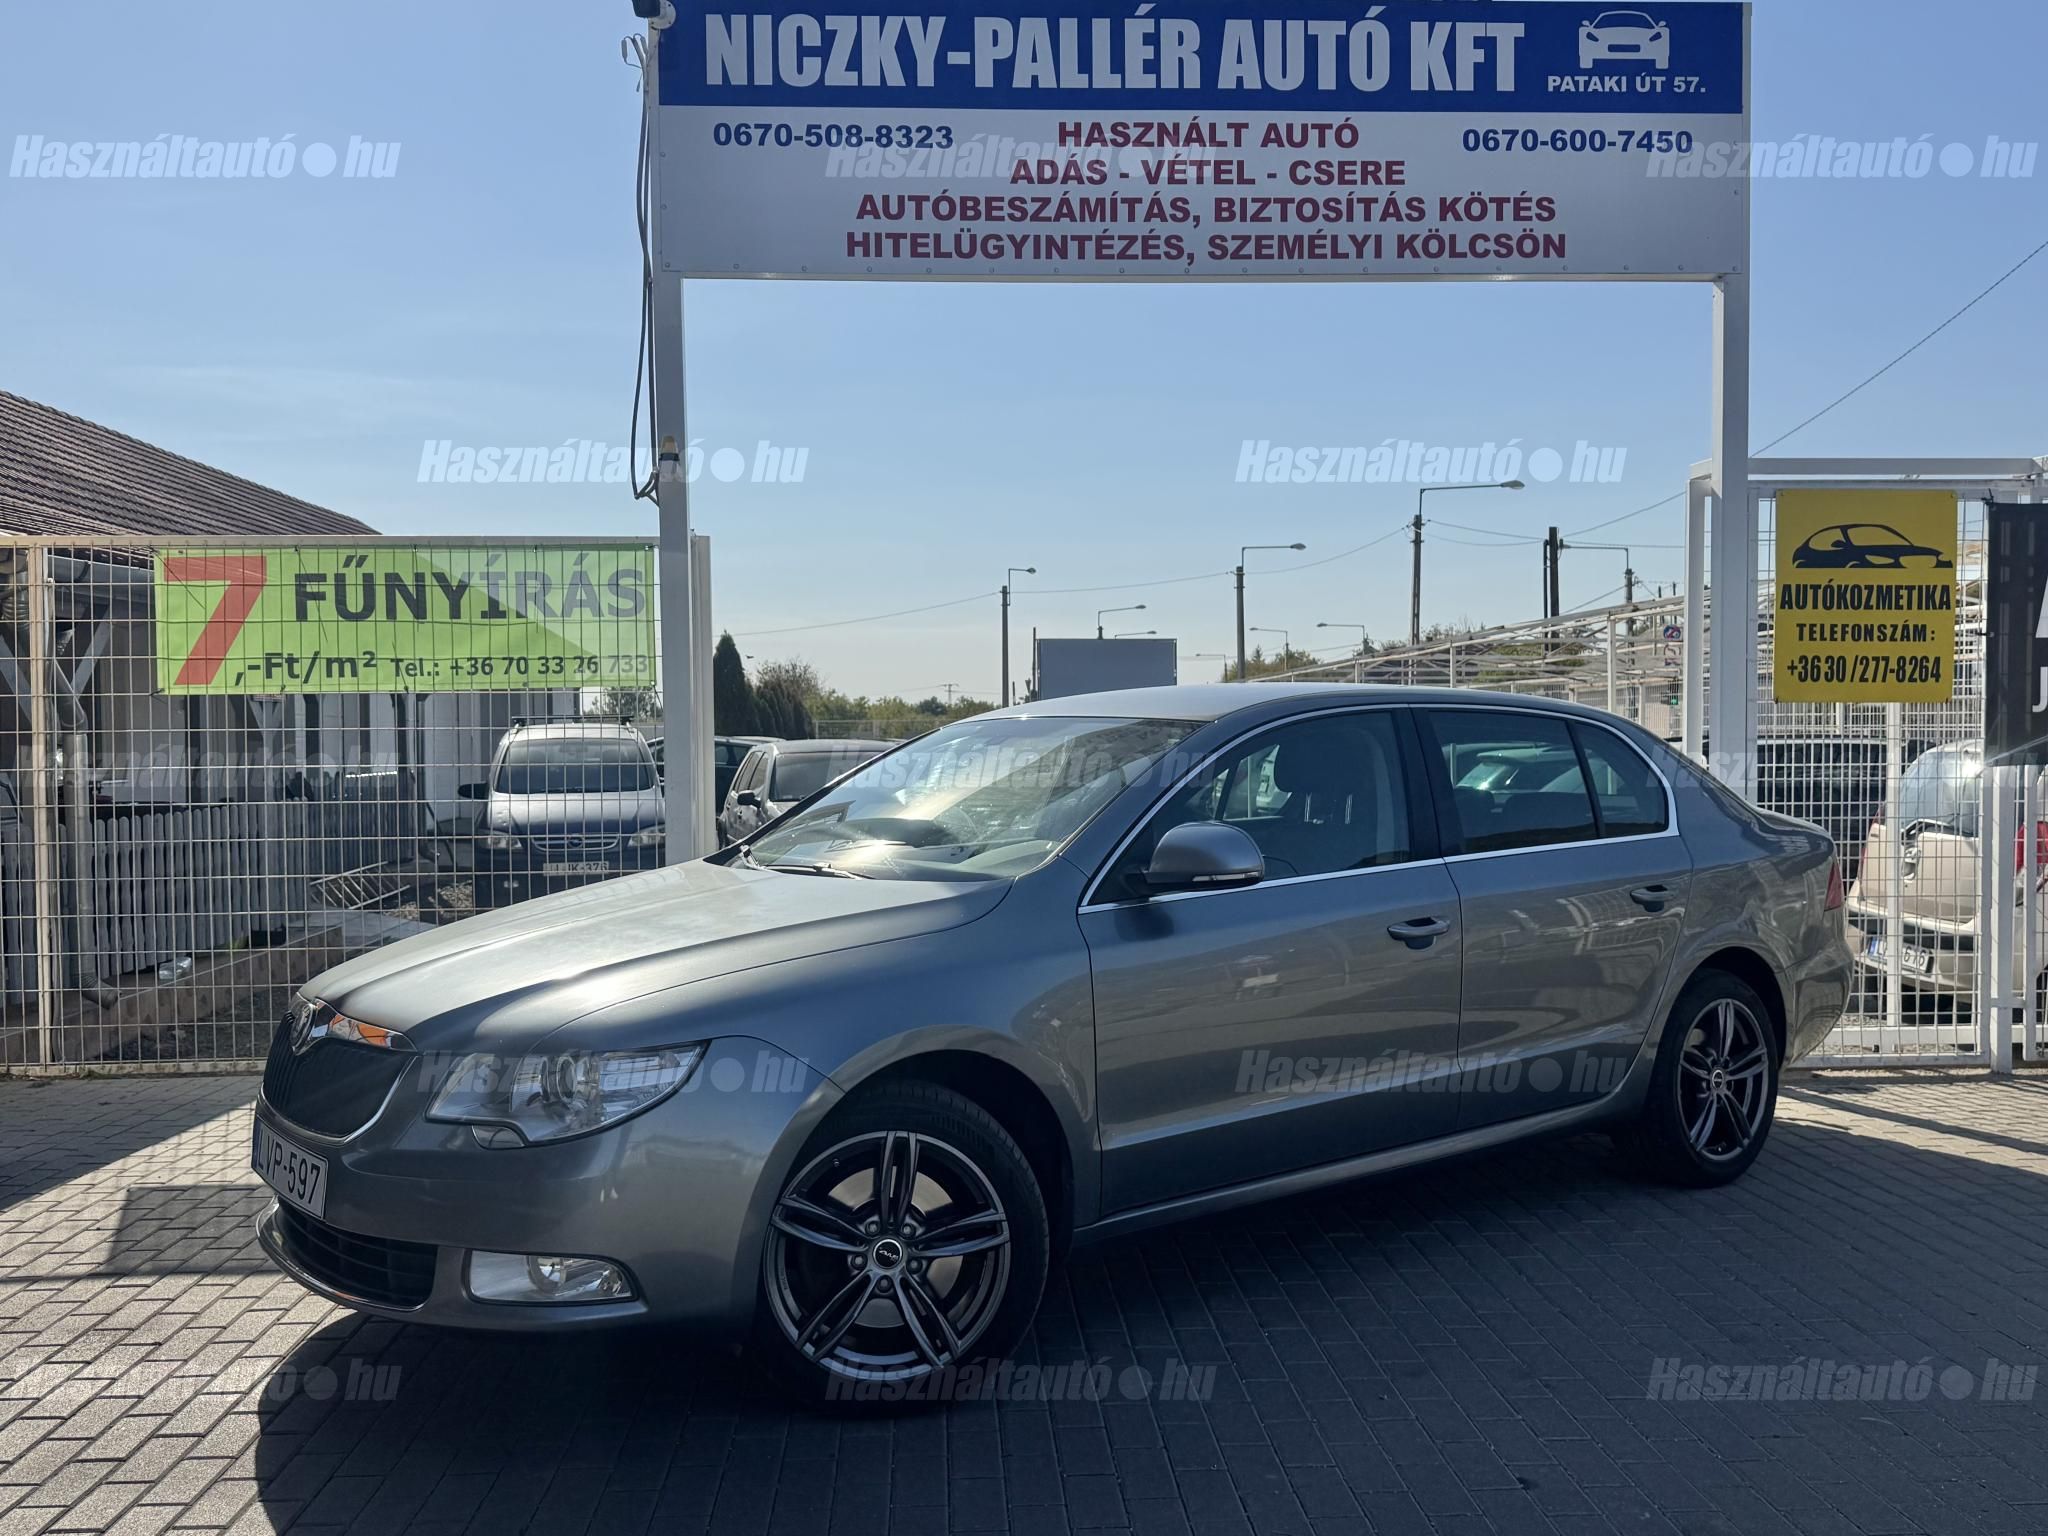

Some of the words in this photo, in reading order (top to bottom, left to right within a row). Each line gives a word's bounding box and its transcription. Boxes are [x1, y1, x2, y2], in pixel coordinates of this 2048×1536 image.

[706, 4, 1200, 88] NICZKY-PALLÉR
[1218, 6, 1390, 91] AUTÓ
[1411, 21, 1525, 91] KFT
[1547, 76, 1627, 92] PATAKI
[1636, 72, 1666, 92] ÚT
[1673, 76, 1706, 93] 57.
[714, 122, 953, 149] 0670-508-8323
[1058, 116, 1249, 148] HASZNÁLT
[1261, 117, 1359, 149] AUTÓ
[1462, 129, 1693, 154] 0670-600-7450
[1010, 155, 1107, 185] ADÁS
[1143, 155, 1256, 186] VÉTEL
[1289, 159, 1406, 186] CSERE
[856, 190, 1200, 228] AUTÓBESZÁMÍTÁS,
[1214, 192, 1426, 224] BIZTOSÍTÁS
[1439, 192, 1556, 223] KÖTÉS
[847, 228, 1195, 265] HITELÜGYINTÉZÉS,
[1208, 230, 1383, 260] SZEMÉLYI
[1397, 229, 1566, 260] KÖLCSÖN
[294, 553, 645, 623] FŰNYÍRÁS
[1780, 579, 1952, 611] AUTÓKOZMETIKA
[163, 556, 267, 685] 7
[1796, 620, 1936, 642] TELEFONSZÁM:
[390, 657, 440, 678] Tel.:
[450, 656, 494, 676] +36
[503, 656, 529, 675] 70
[537, 656, 564, 675] 33
[607, 655, 648, 674] 733
[258, 1127, 321, 1205] LVP-597
